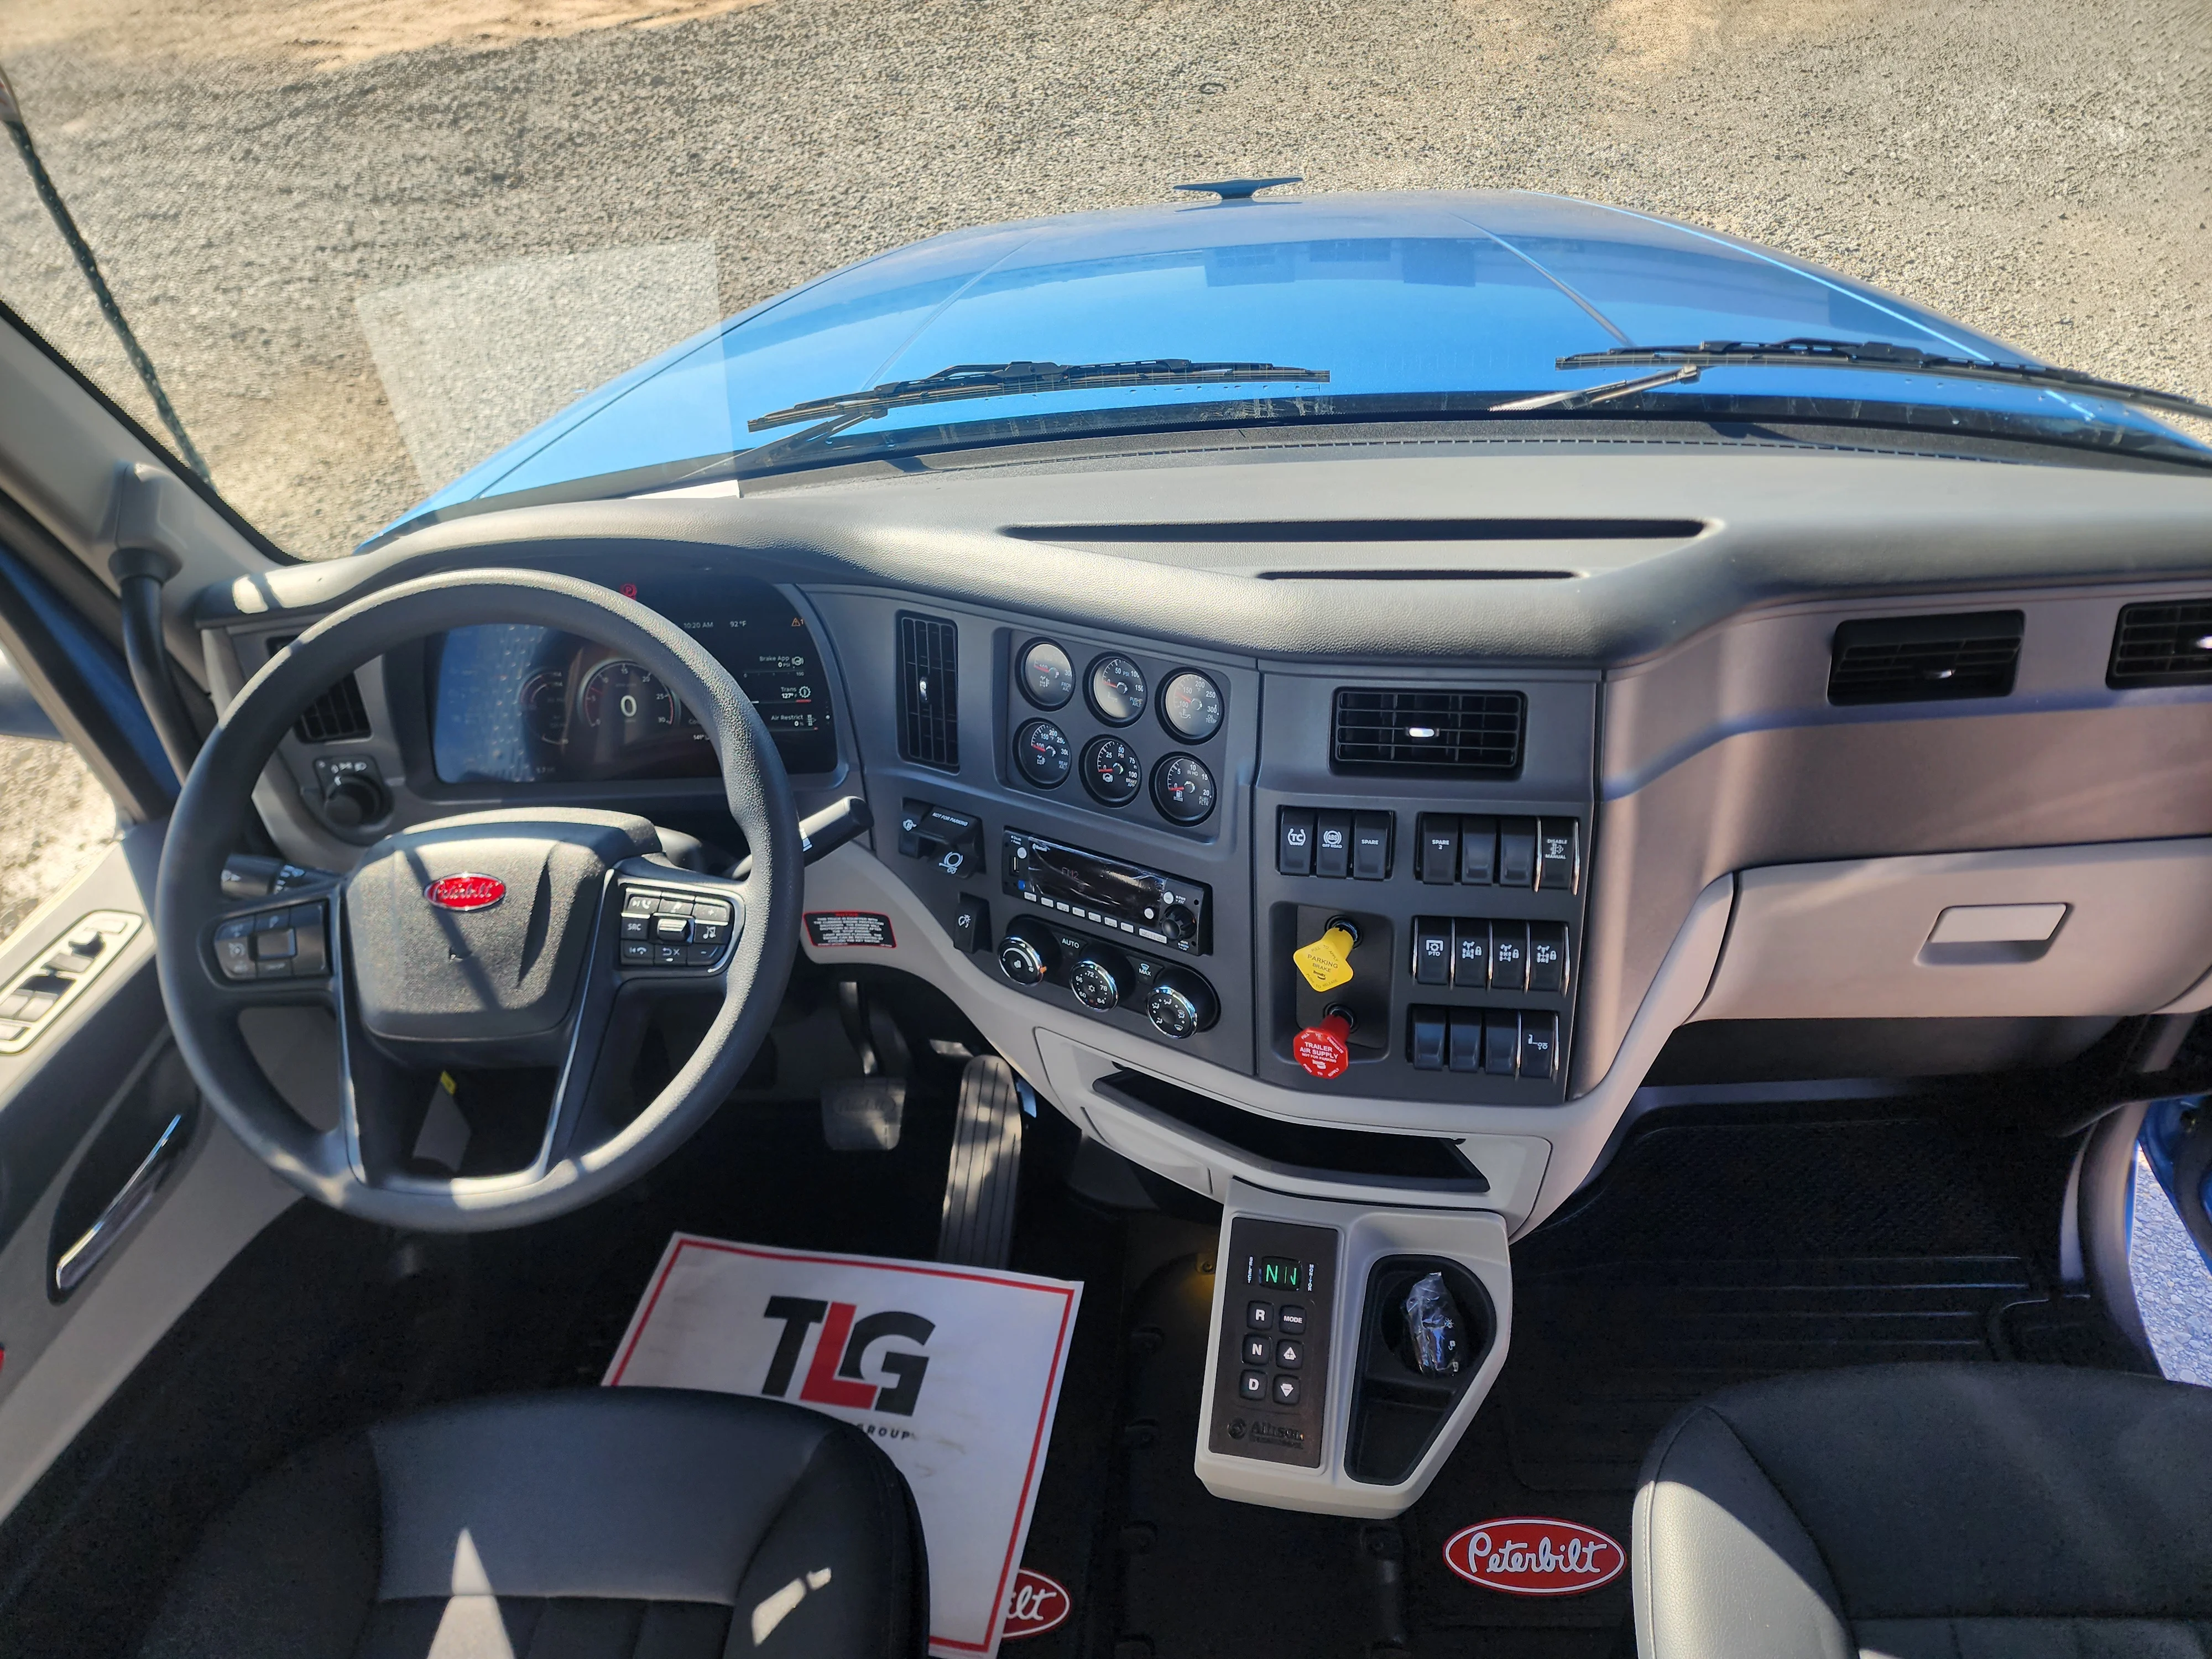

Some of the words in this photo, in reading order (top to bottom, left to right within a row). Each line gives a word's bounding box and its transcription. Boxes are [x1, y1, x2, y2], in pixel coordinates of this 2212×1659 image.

[1135, 684, 1144, 692] 150
[1206, 690, 1216, 698] 250
[620, 695, 637, 717] 0
[950, 817, 968, 827] PARKING
[627, 923, 641, 931] SRC
[1062, 938, 1079, 950] AUTO
[1307, 954, 1338, 969] PARKING
[1139, 968, 1151, 977] MAX
[1312, 963, 1332, 973] BRAKE
[1304, 1041, 1333, 1052] TRAILER
[1312, 1049, 1339, 1060] SUPPLY
[1265, 1264, 1278, 1283] N
[1255, 1309, 1265, 1321] R
[1284, 1315, 1303, 1324] MODE
[1252, 1343, 1262, 1356] N
[761, 1295, 936, 1417] TLG
[1248, 1378, 1259, 1391] D
[1468, 1532, 1608, 1573] Peterbilt
